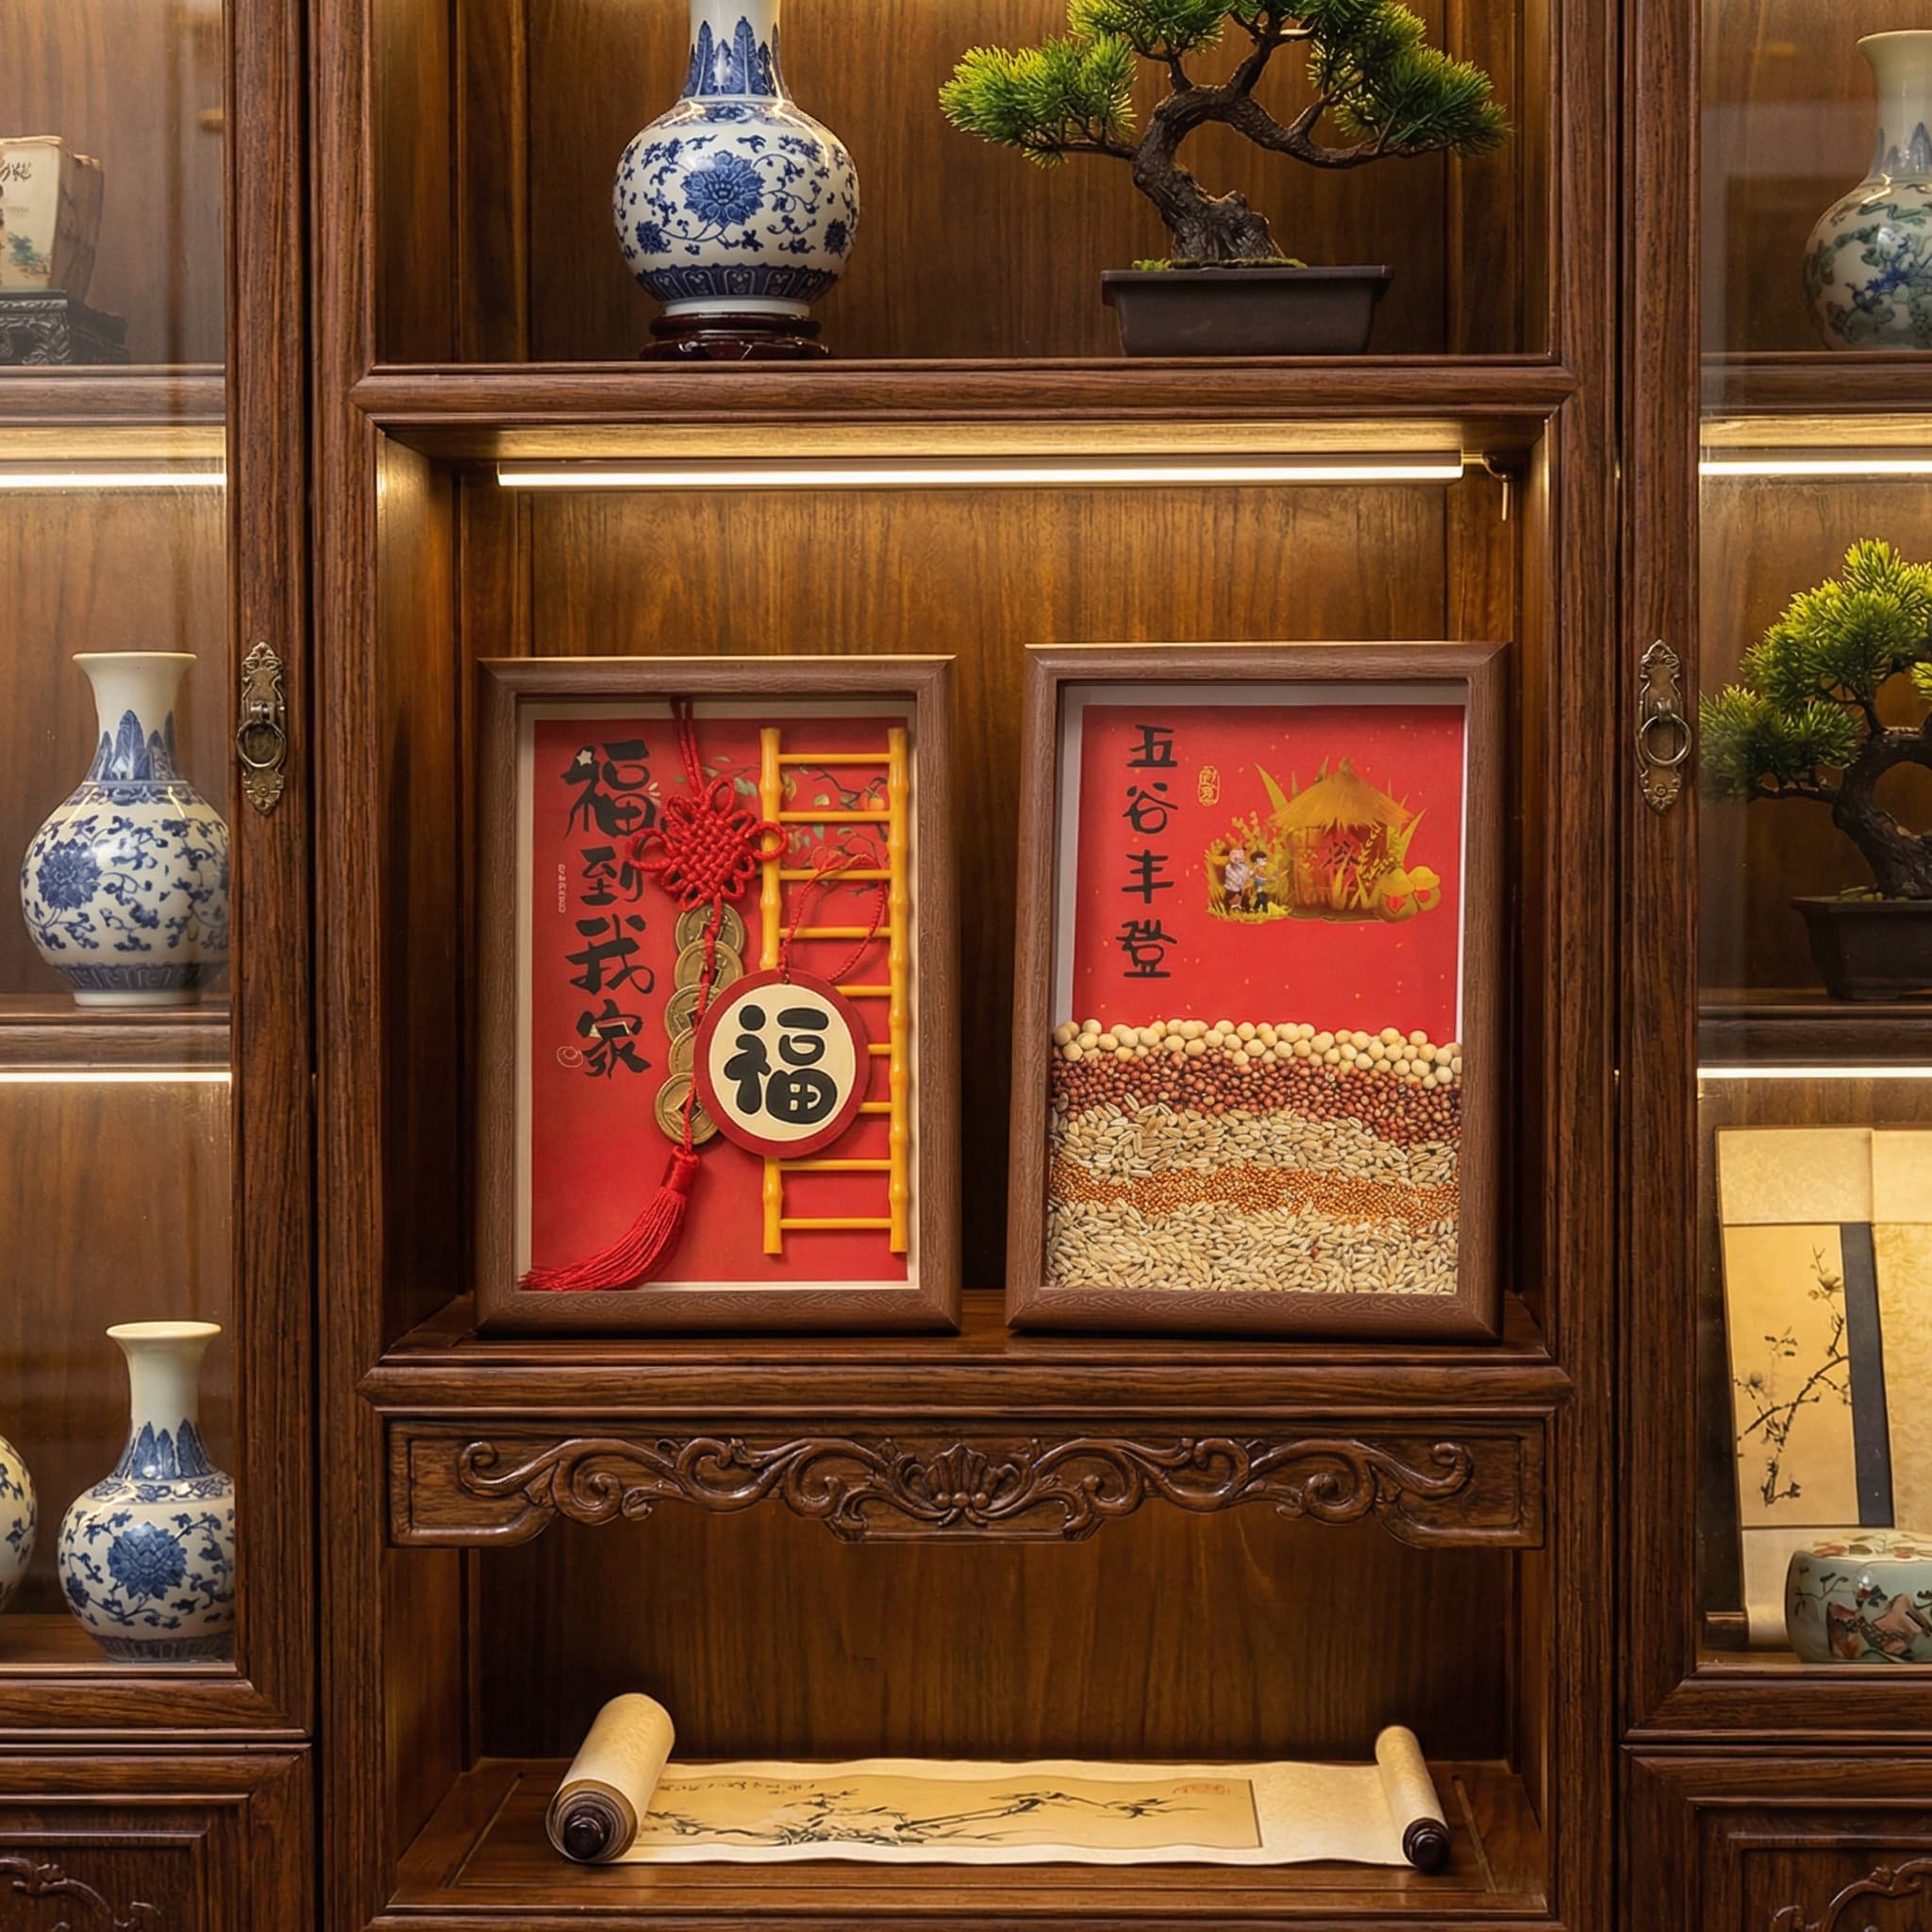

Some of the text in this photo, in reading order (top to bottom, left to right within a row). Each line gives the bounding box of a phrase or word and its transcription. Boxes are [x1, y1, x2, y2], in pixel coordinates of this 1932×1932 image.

[560, 739, 658, 1079] 福到我家
[1115, 724, 1178, 977] 五谷丰登
[724, 1004, 838, 1124] 福
